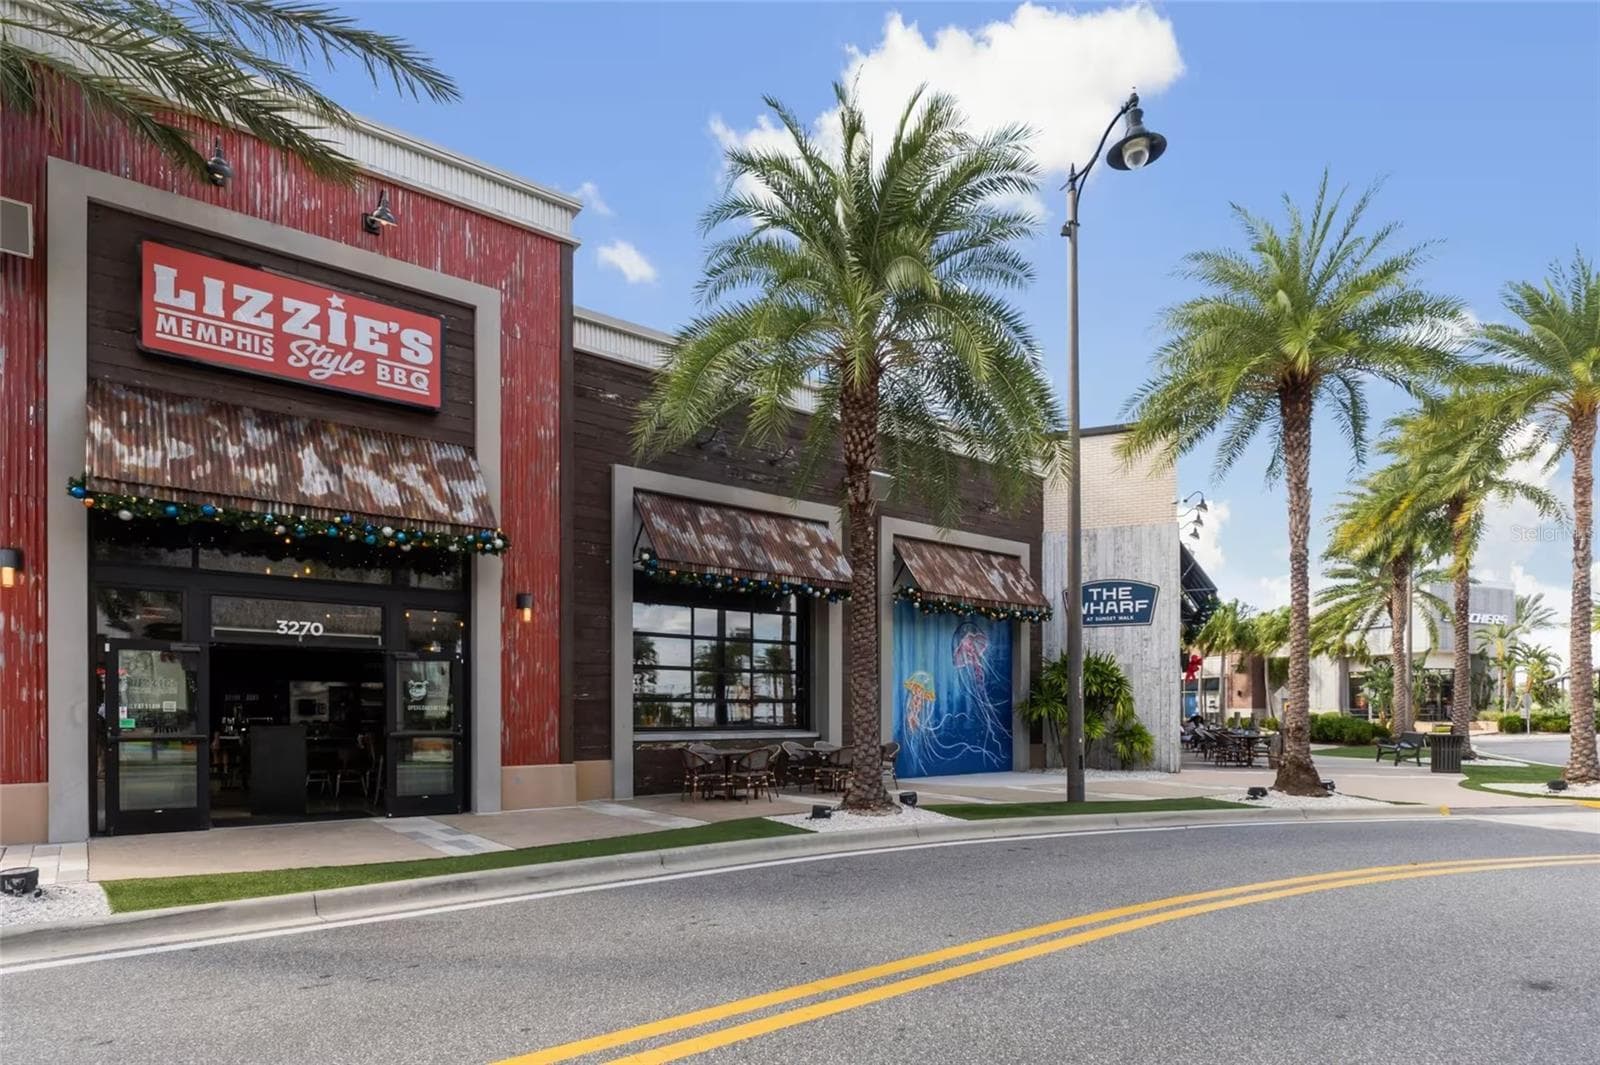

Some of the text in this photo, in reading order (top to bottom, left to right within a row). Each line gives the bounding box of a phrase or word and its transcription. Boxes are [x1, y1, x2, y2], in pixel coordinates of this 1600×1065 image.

[153, 263, 433, 366] LIZZIE'S
[156, 313, 430, 391] MEMPHIS Style BBQ
[1088, 587, 1132, 600] THE
[276, 620, 324, 636] 3270
